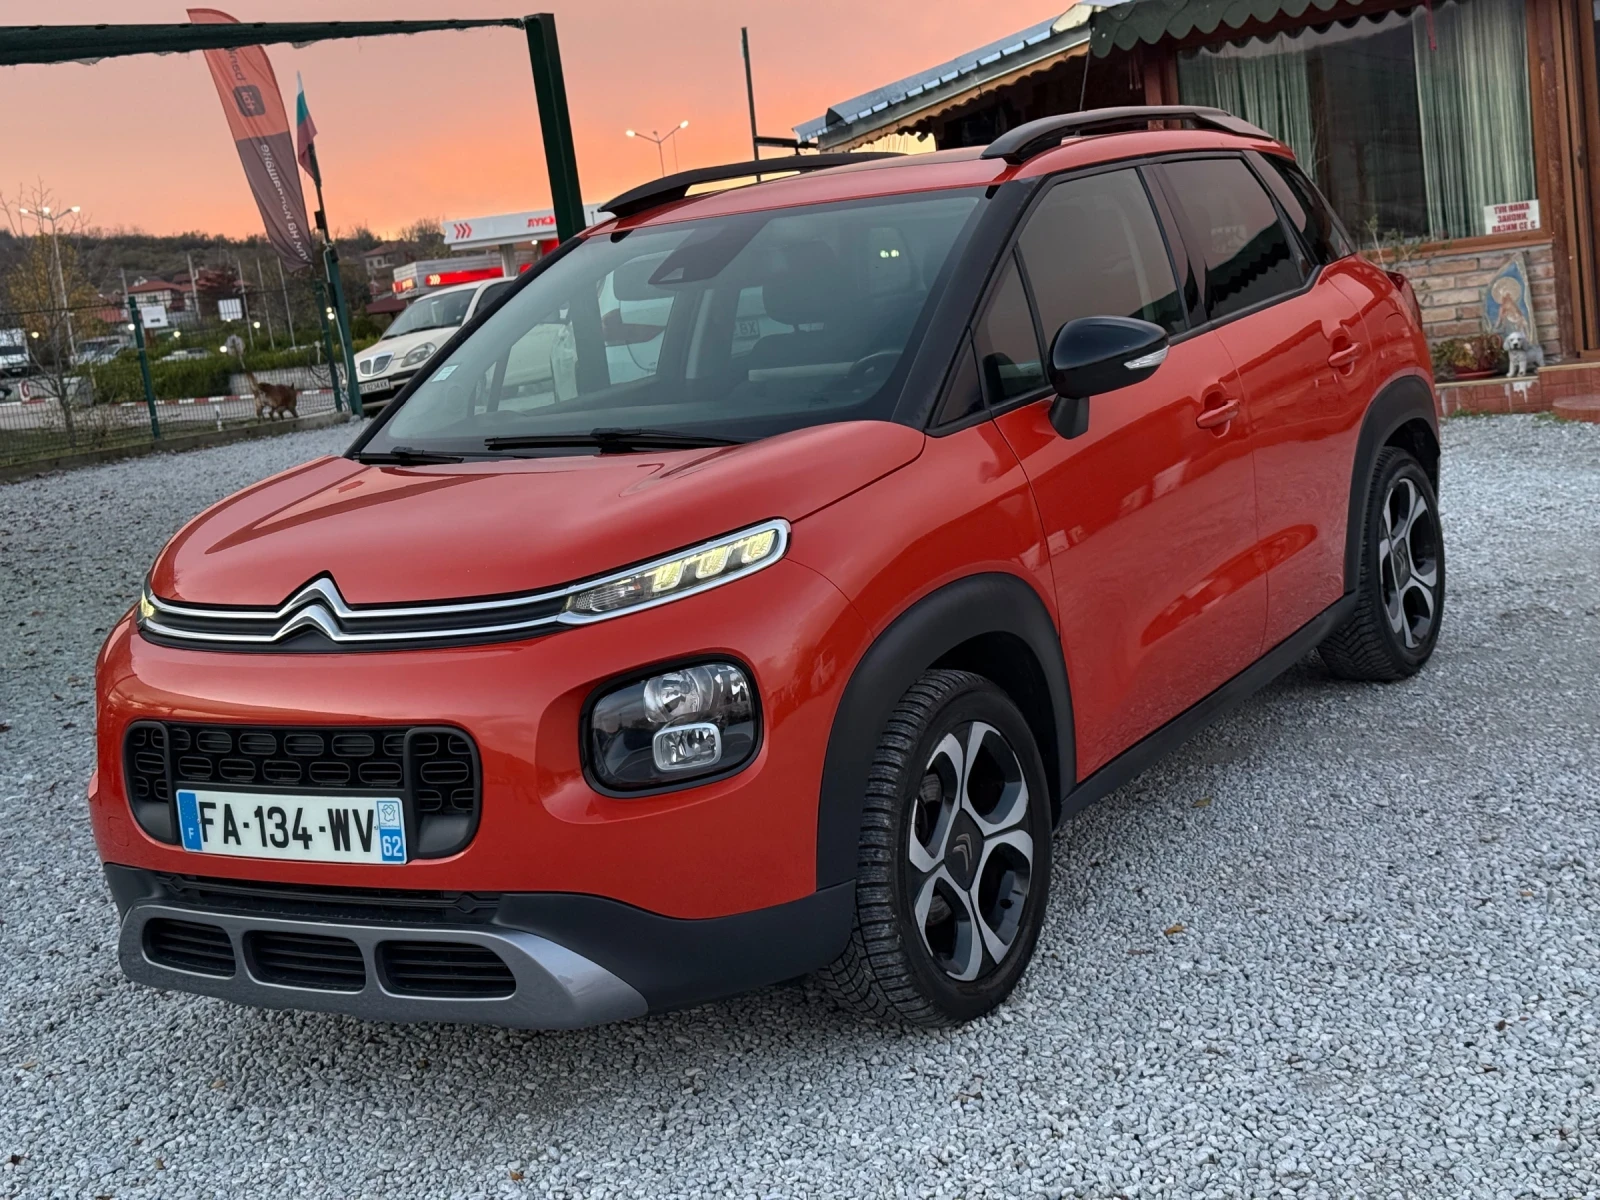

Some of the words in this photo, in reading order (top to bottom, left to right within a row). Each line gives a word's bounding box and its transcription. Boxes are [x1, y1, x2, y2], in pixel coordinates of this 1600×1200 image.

[527, 215, 556, 227] ЛУКО
[1519, 221, 1528, 230] СЕ
[188, 828, 194, 840] F
[198, 801, 374, 853] FA-134-WV
[382, 835, 403, 857] 62
